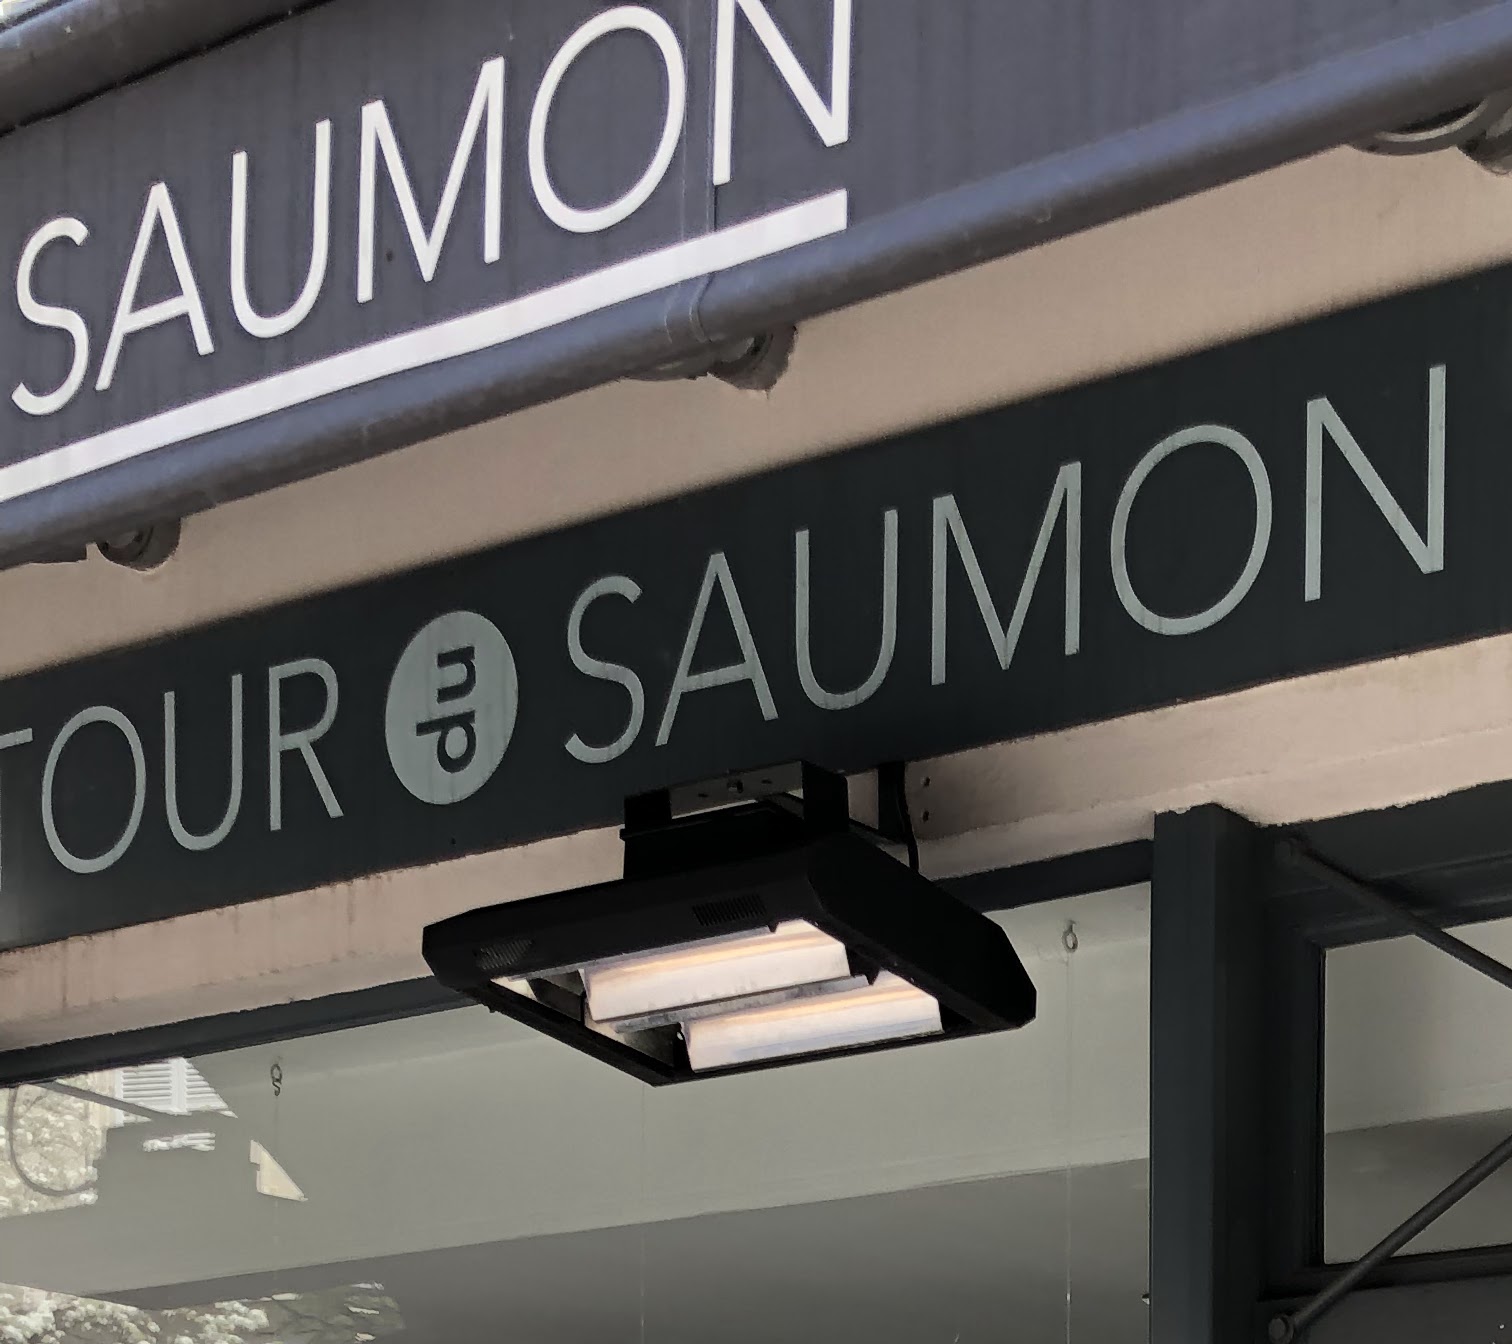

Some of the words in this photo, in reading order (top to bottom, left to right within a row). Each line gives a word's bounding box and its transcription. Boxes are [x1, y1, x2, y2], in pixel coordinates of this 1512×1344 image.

[12, 0, 852, 417] SAUMON
[415, 645, 477, 775] du
[564, 364, 1446, 764] SAUMON
